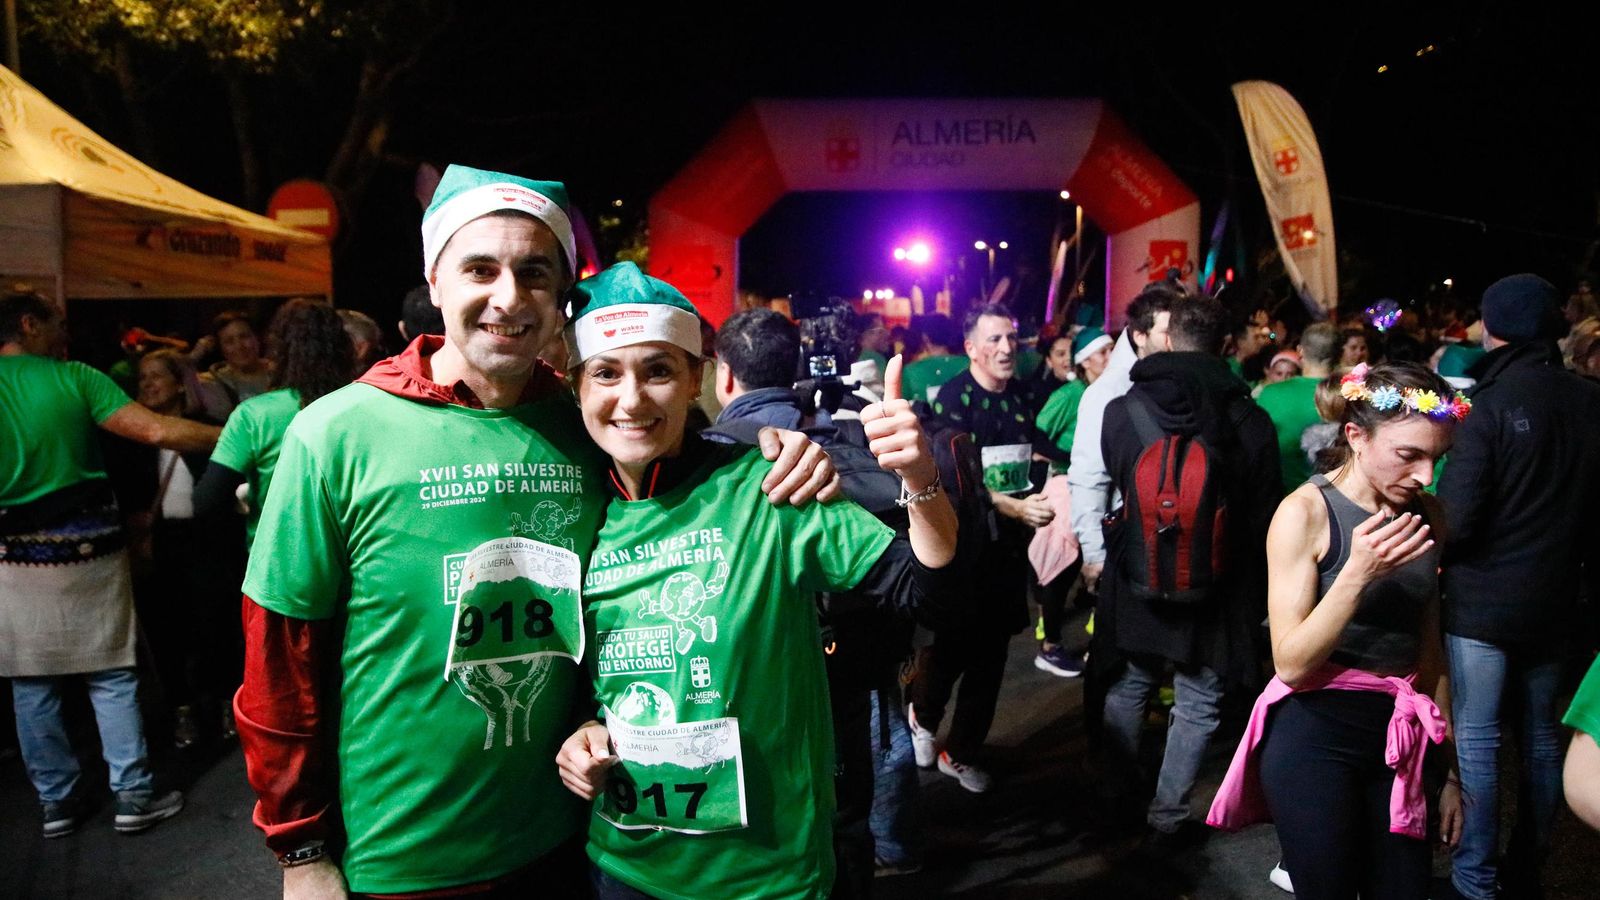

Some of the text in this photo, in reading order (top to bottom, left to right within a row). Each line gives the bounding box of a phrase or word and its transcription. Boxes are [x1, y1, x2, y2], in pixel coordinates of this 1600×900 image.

[892, 114, 1036, 146] ALMERÍA
[418, 462, 583, 484] XVII SAN SILVESTRE
[419, 478, 583, 501] CIUDAD DE ALMERÍA
[422, 496, 486, 510] 29 DICIEMBRE 2024
[505, 541, 534, 551] CIUDAD
[535, 545, 544, 555] DE
[601, 548, 632, 567] SAN
[634, 527, 724, 561] SILVESTRE
[480, 557, 515, 570] ALMERÍA
[626, 562, 646, 577] DE
[648, 543, 725, 572] ALMERÍA
[455, 598, 554, 648] 918
[624, 632, 636, 641] TU
[638, 629, 669, 641] SALUD
[599, 639, 671, 660] PROTEGE
[599, 656, 673, 672] TU ENTORNO
[686, 689, 721, 702] ALMERÍA
[647, 728, 679, 737] CIUDAD
[610, 777, 708, 820] 917
